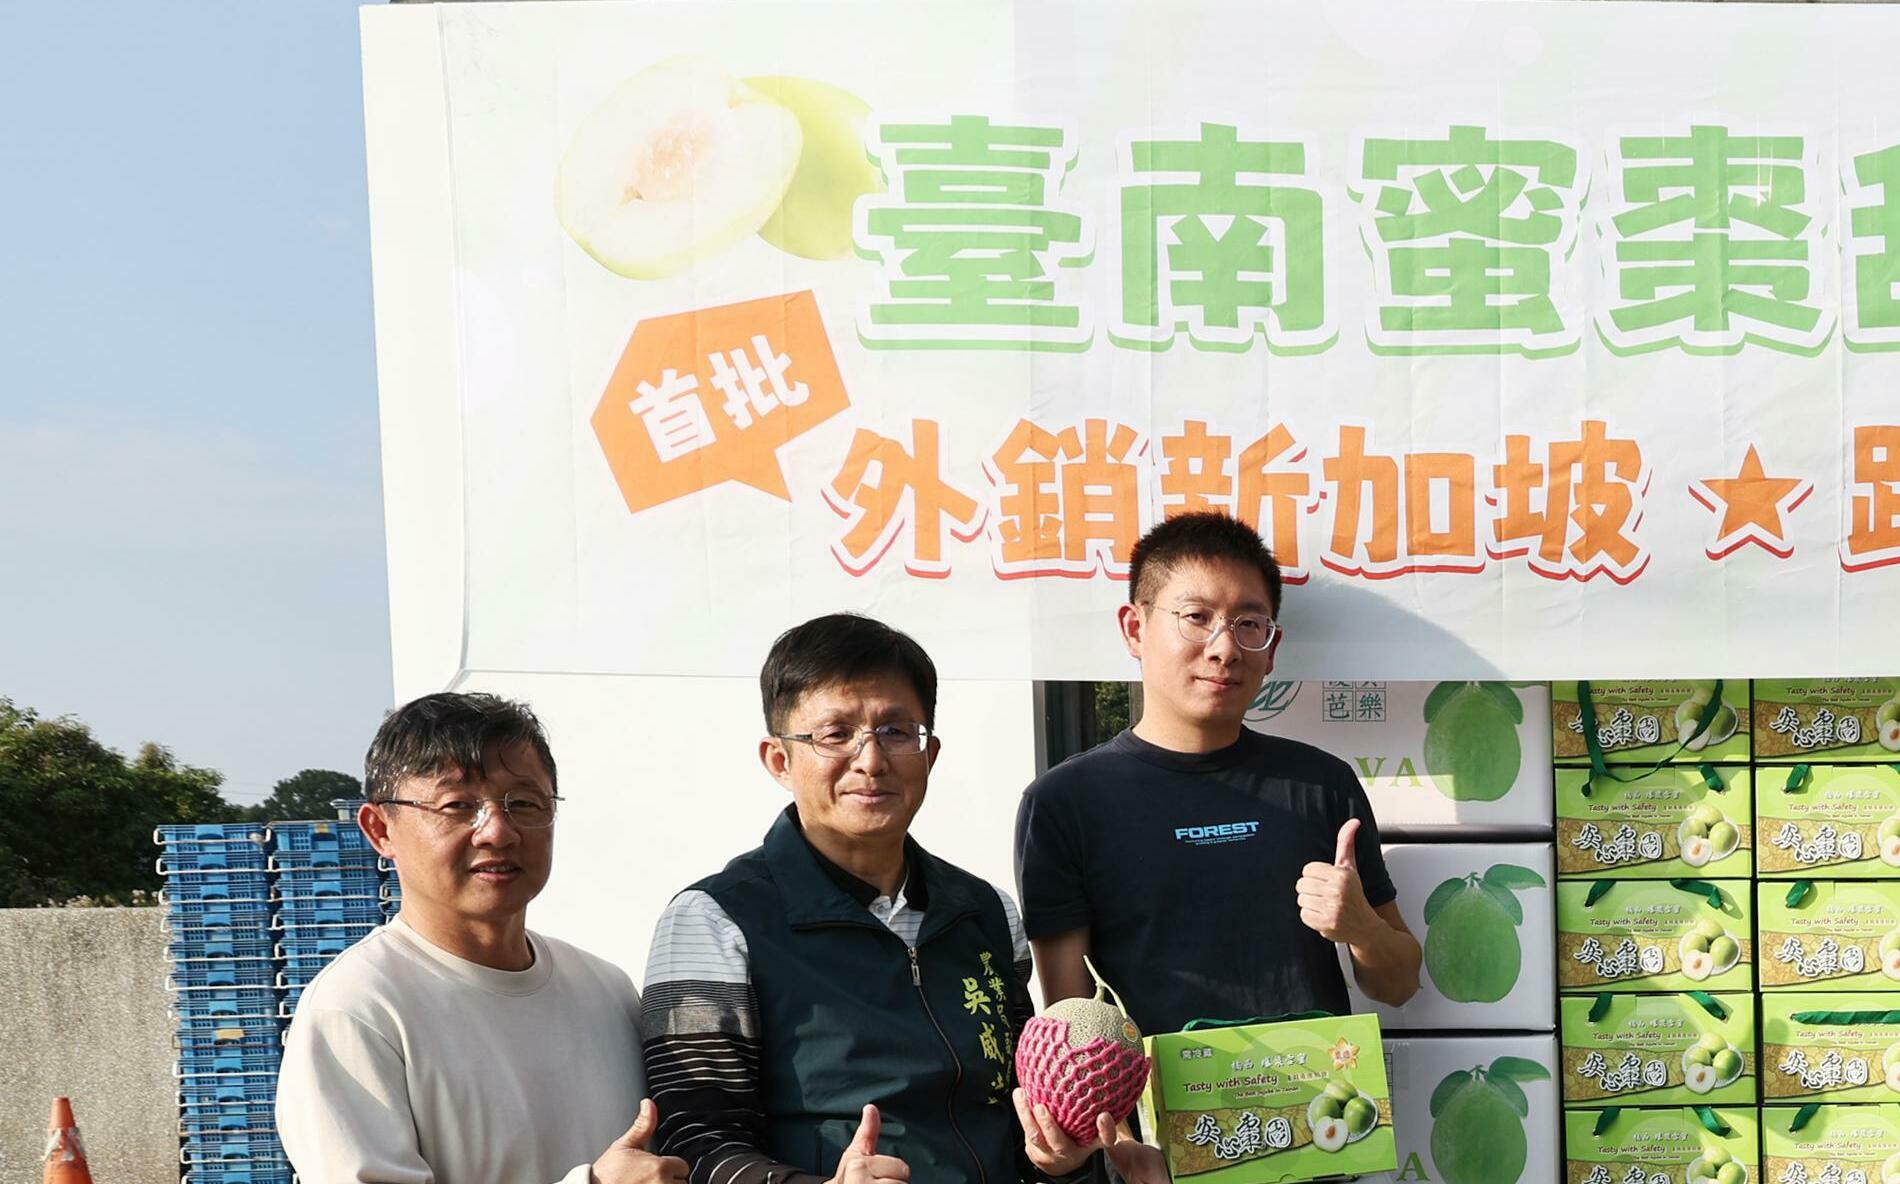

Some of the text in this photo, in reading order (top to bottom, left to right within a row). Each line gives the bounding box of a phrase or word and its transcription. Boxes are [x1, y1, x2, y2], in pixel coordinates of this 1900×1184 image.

[628, 333, 811, 465] 首批
[828, 415, 1648, 582] 外銷新加坡
[1591, 686, 1655, 696] asty with Safety
[1787, 686, 1856, 697] Tasty with Safety
[1588, 802, 1656, 813] Tasty with Safety
[1789, 802, 1858, 813] Tasty with Safety
[1175, 821, 1259, 840] FOREST
[1590, 917, 1658, 927] Tasty with Safety
[1791, 916, 1859, 927] Tasty with Safety
[1593, 1031, 1661, 1042] Tasty with Safety
[1796, 1029, 1864, 1040] Tasty with Safety
[1183, 1074, 1278, 1093] Tasty with Safety
[1598, 1144, 1665, 1155] Tasty with Safety
[1794, 1141, 1861, 1152] Tasty with Safety
